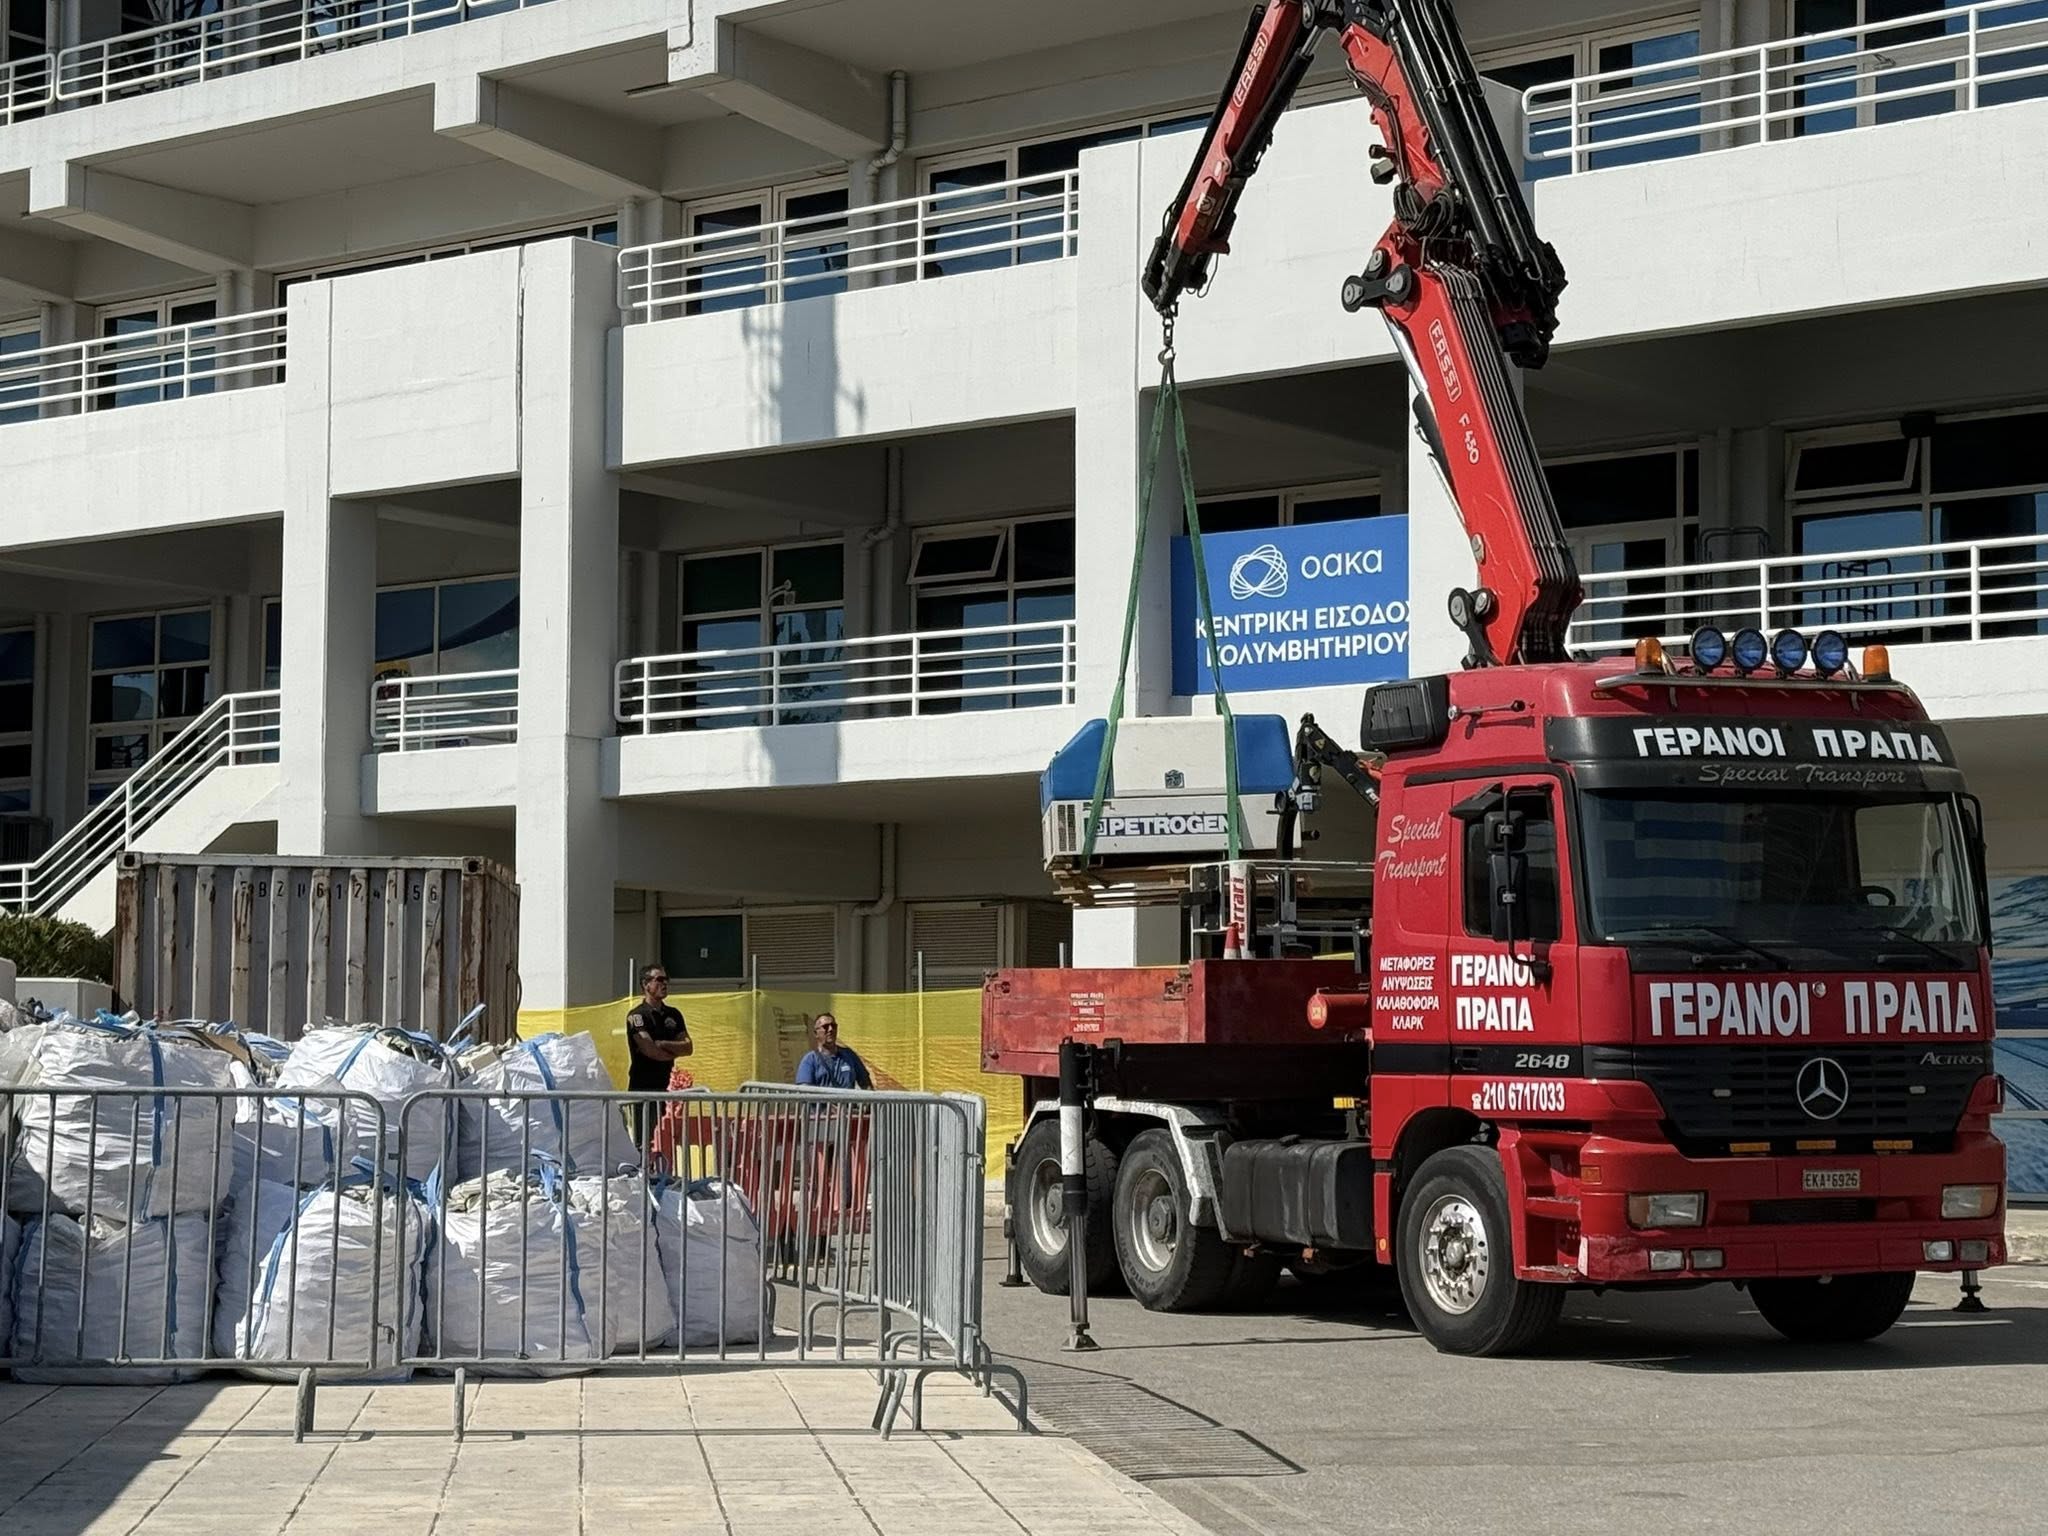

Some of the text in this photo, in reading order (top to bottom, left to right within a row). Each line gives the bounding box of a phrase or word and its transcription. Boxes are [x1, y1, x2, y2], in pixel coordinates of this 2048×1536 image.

[1236, 37, 1266, 102] FASSI
[1432, 325, 1459, 398] FASSI
[1459, 413, 1470, 427] F
[1196, 609, 1308, 638] ΚΕΝΤΡΙΚΗ
[1632, 727, 1943, 764] ΓΕΡΑΝΟΙ ΠΡΑΠΑ
[1698, 763, 1907, 788] Special Transport
[1110, 815, 1229, 836] PETROGEN
[1387, 812, 1444, 848] Special
[1378, 852, 1448, 886] Transport
[1379, 956, 1436, 971] ΜΕΤΑΦΟΡΕΣ
[1381, 976, 1434, 991] ΑΝΥΨΩΣΕΙΣ
[1376, 995, 1440, 1011] ΚΑΛΑΘΟΦΟΡΑ
[1456, 996, 1535, 1032] ΠΡΑΠΑ
[1649, 981, 1978, 1036] ΓΕΡΑΝΟΙ ΠΡΑΠΑ
[1391, 1016, 1425, 1030] ΚΛΑΡΚ
[1515, 1053, 1570, 1069] 2648
[1482, 1081, 1565, 1112] 210 6717033
